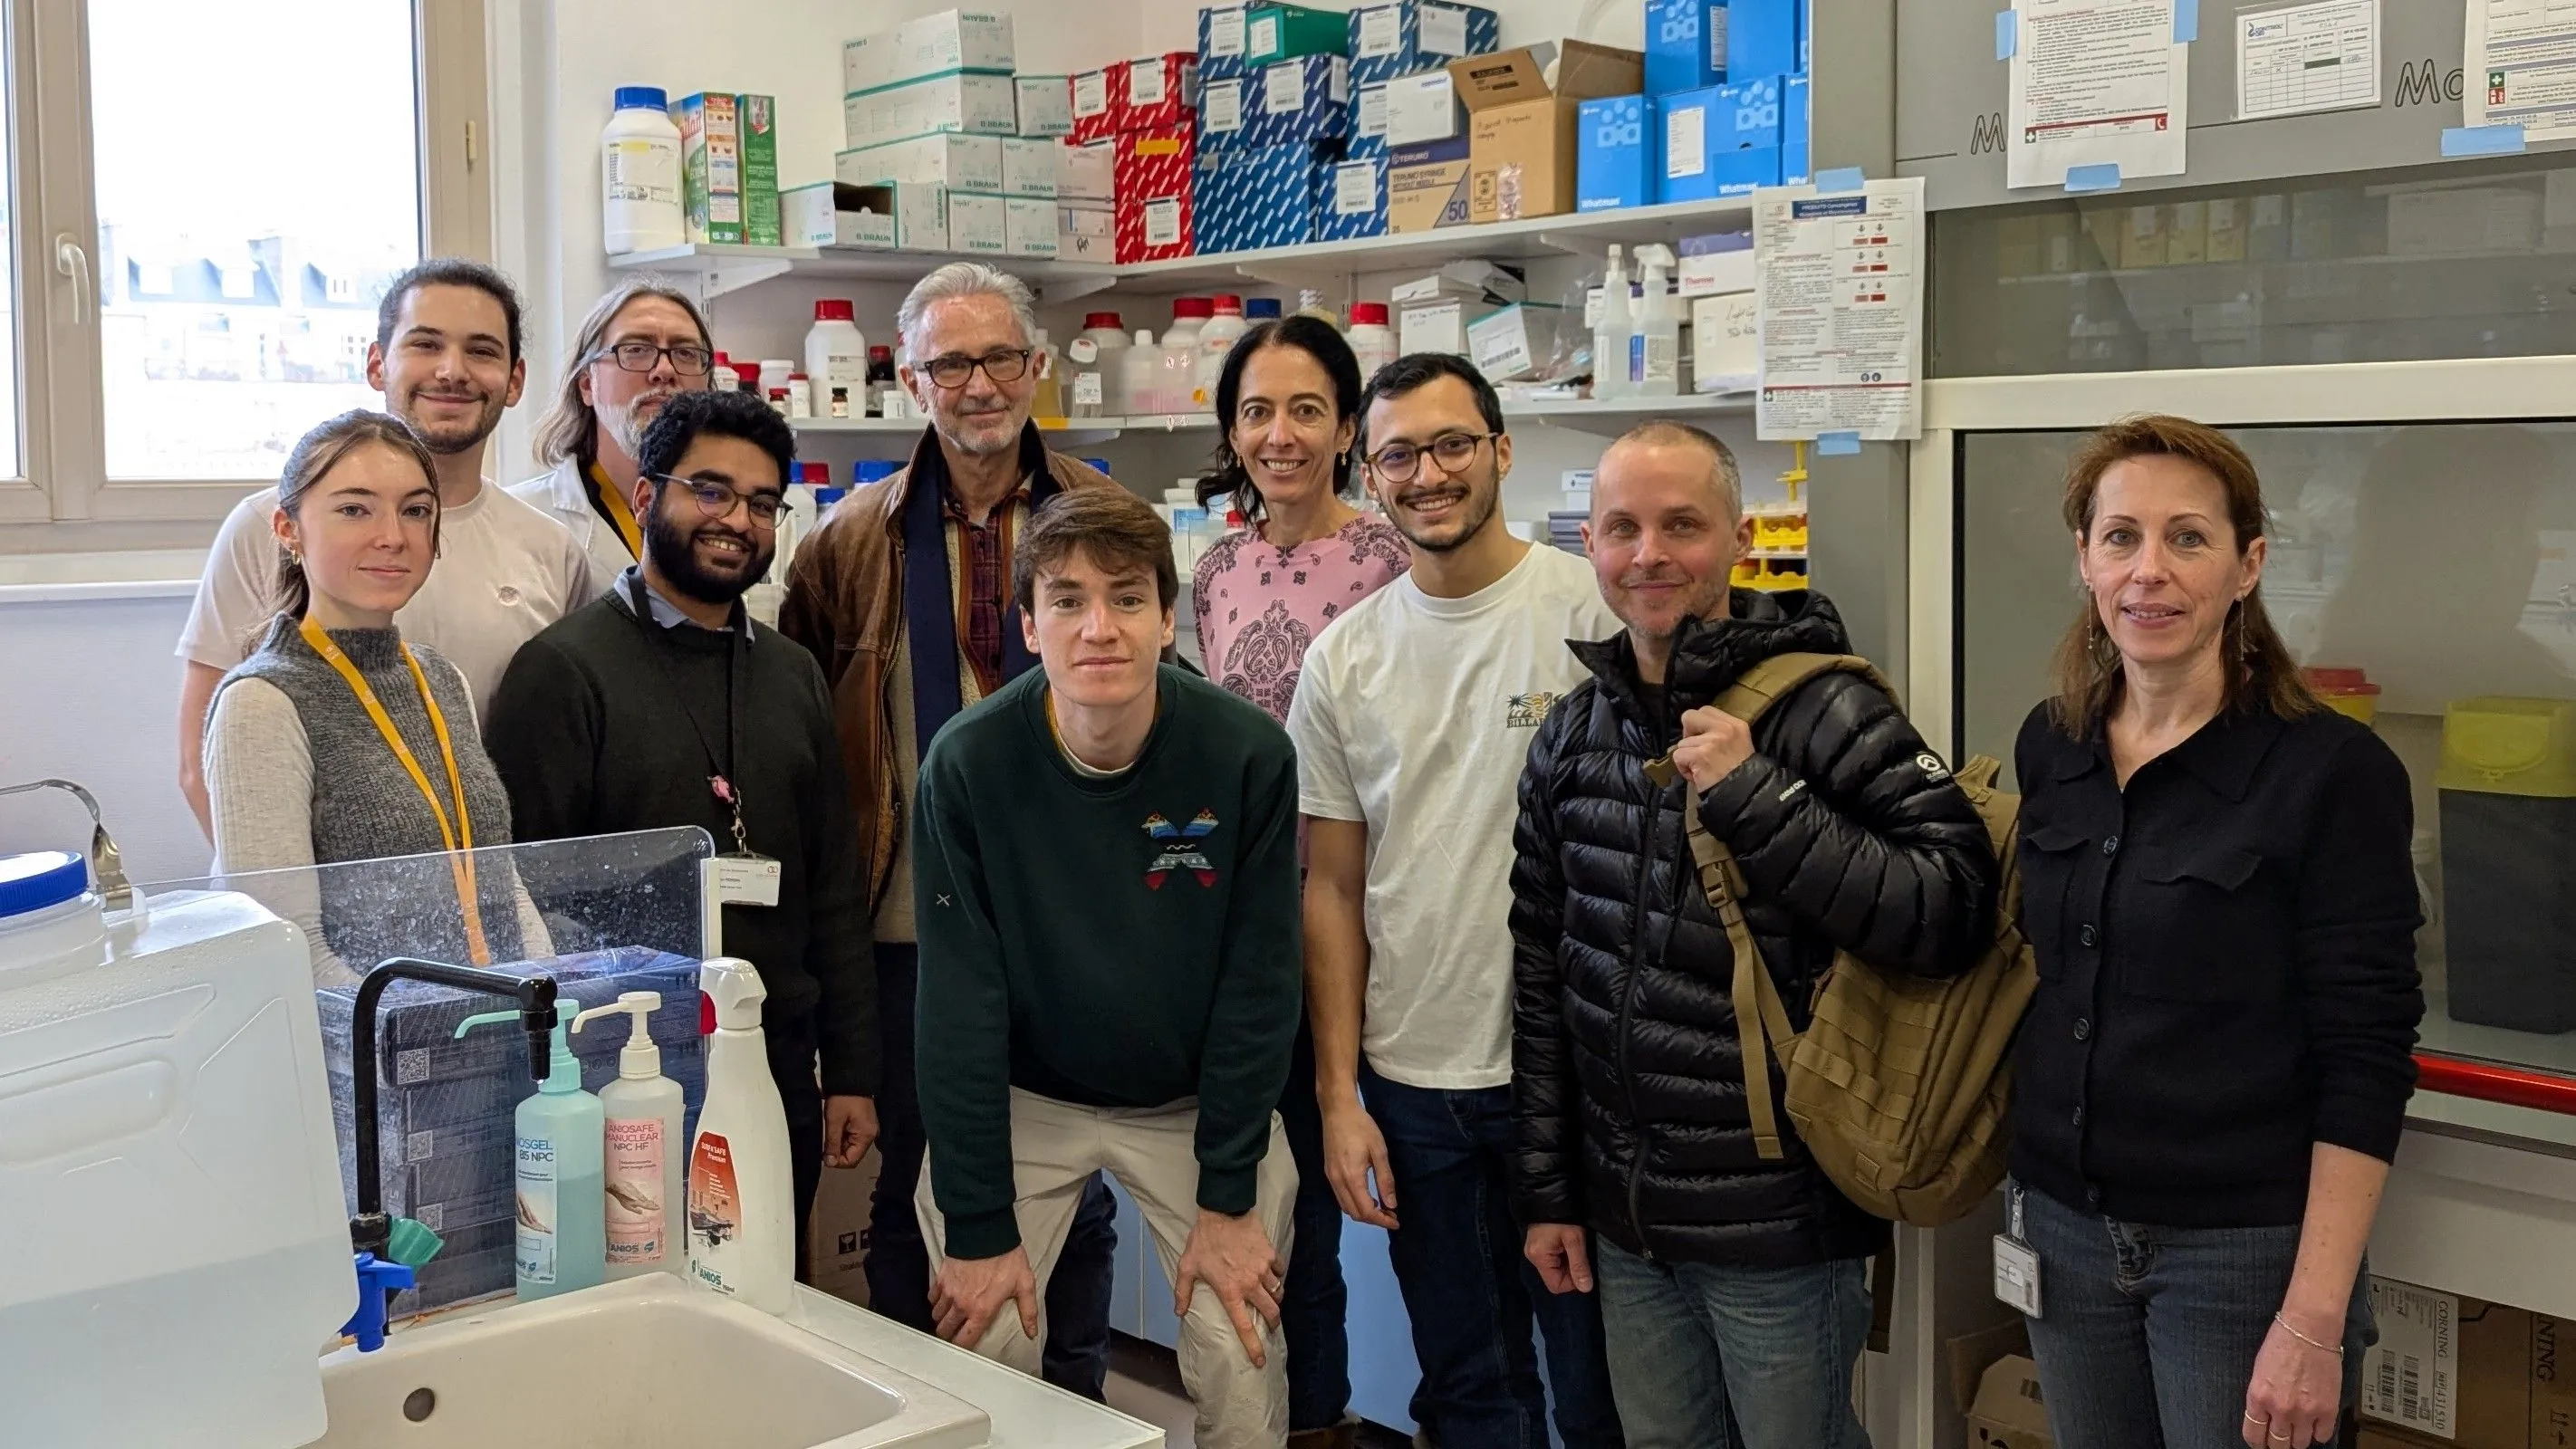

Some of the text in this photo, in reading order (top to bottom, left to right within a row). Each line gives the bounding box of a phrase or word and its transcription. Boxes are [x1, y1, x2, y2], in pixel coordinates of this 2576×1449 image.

[1399, 151, 1429, 163] TERUMO
[1028, 184, 1054, 192] BRAUN
[1448, 199, 1468, 221] 50
[863, 233, 891, 242] BRAUN
[976, 241, 1003, 249] BRAUN
[608, 1124, 655, 1134] ANIOSAFE
[613, 1141, 649, 1151] NPC HF
[519, 1149, 554, 1162] 85 NPC
[610, 1243, 639, 1252] ANIOS
[699, 1267, 722, 1286] ANIOS
[2437, 1300, 2449, 1359] CORNING
[2536, 1316, 2557, 1382] NING
